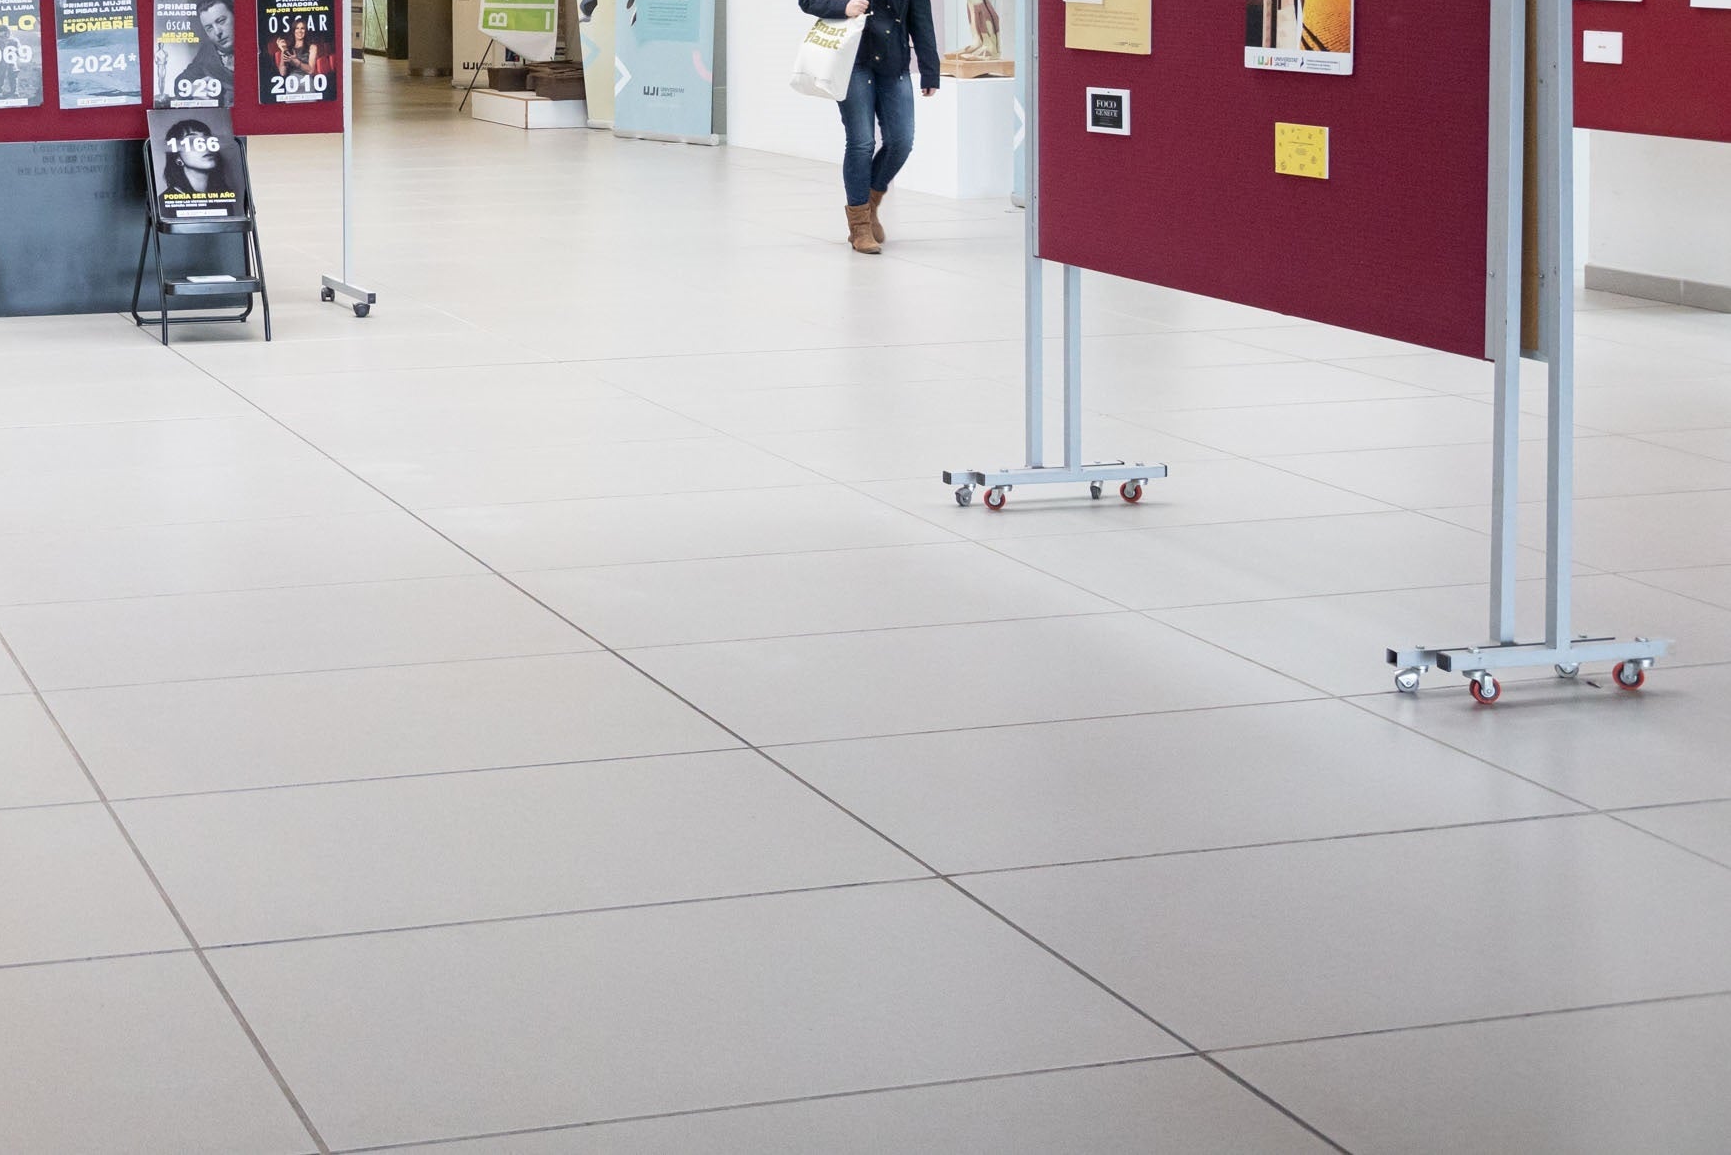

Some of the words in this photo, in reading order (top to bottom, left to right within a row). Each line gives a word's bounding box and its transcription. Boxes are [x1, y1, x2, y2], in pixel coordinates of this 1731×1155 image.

[13, 4, 35, 12] LUNA
[63, 1, 100, 9] PRIMERA
[102, 0, 132, 7] MUJER
[75, 7, 98, 15] PISAR
[111, 5, 133, 13] LUNA
[157, 3, 197, 11] PRIMER
[63, 19, 134, 33] HOMBRE
[166, 19, 191, 31] ÓSCAR
[268, 13, 328, 34] ÓSAR
[168, 78, 222, 98] 929
[270, 73, 328, 95] 2010
[643, 85, 659, 96] UJI
[1096, 99, 1117, 109] FOCO
[167, 136, 221, 153] 1166
[163, 192, 191, 200] PODRÍA
[219, 191, 236, 199] AÑO
